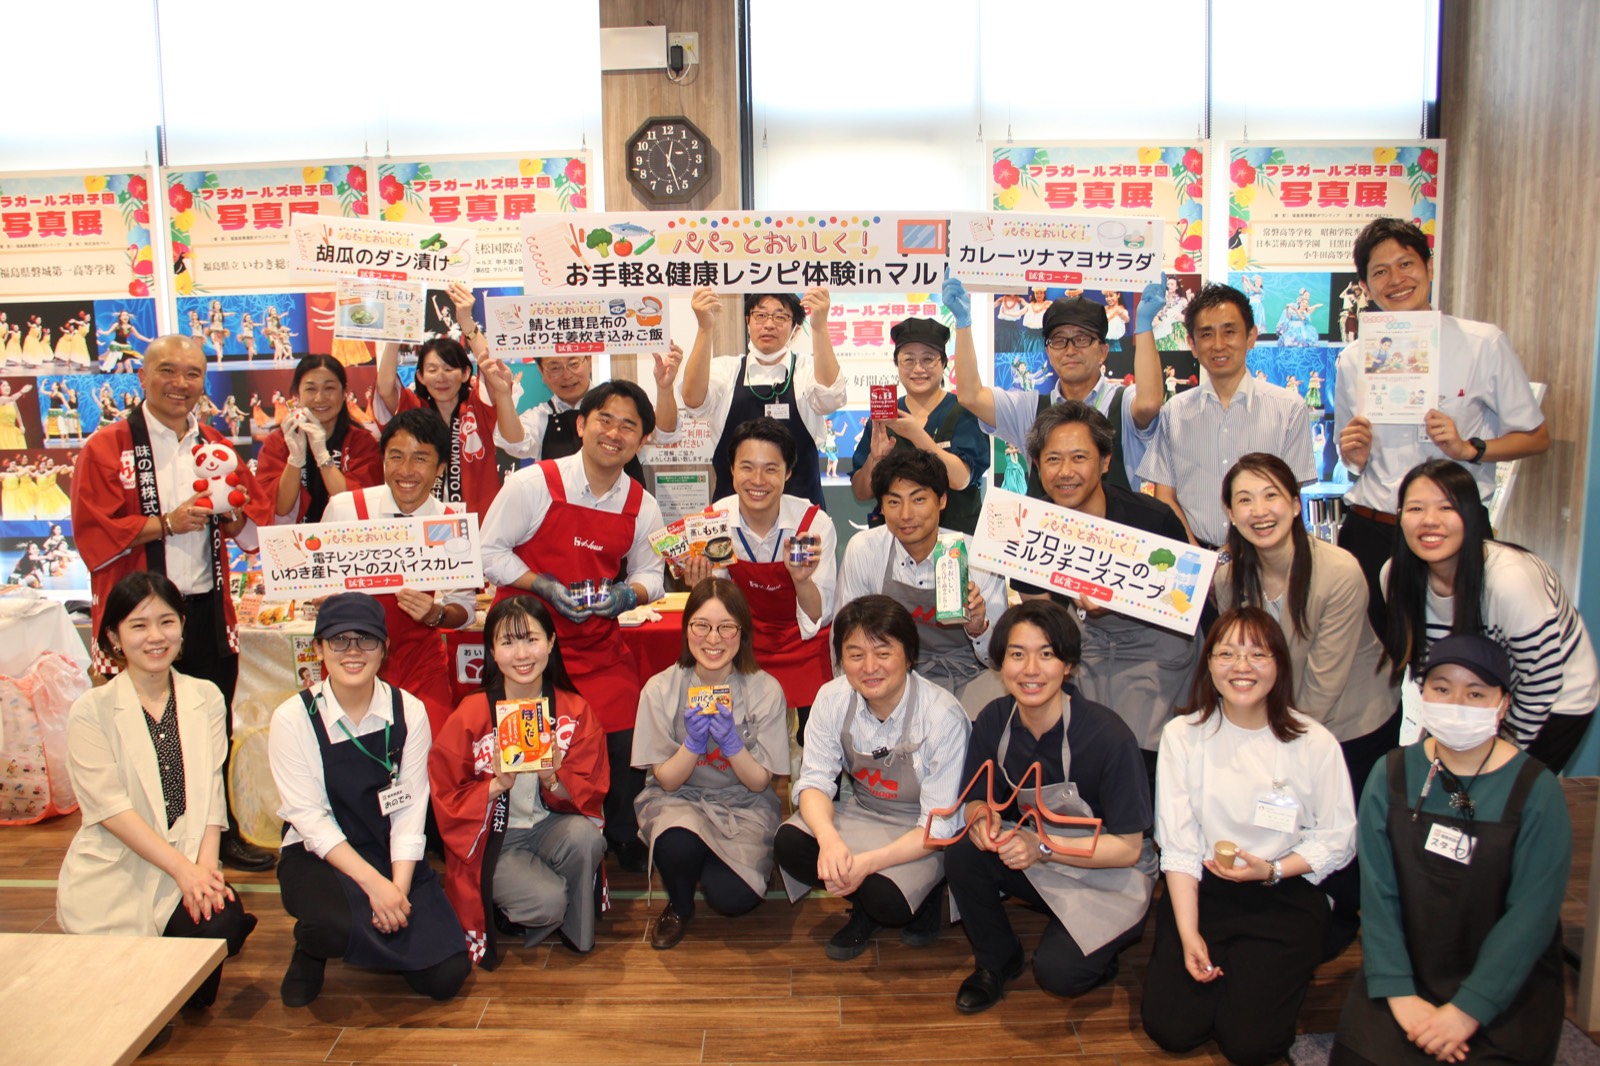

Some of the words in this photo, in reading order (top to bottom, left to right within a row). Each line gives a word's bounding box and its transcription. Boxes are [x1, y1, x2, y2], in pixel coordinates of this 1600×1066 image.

[647, 131, 657, 140] 11
[662, 126, 674, 135] 12
[681, 130, 687, 139] 1
[637, 142, 649, 151] 10
[692, 141, 698, 149] 2
[636, 157, 643, 166] 9
[695, 155, 702, 164] 3
[640, 169, 647, 178] 8
[691, 169, 699, 178] 4
[1029, 164, 1169, 178] フラガールズ甲子園
[1265, 164, 1404, 178] フラガールズ甲子園
[201, 184, 333, 201] フラガールズ甲子園
[413, 177, 551, 193] フラガールズ甲子園
[650, 181, 657, 190] 7
[666, 185, 673, 194] 6
[681, 181, 689, 189] 5
[1044, 181, 1154, 210] 写真展
[1279, 180, 1388, 209] 写真展
[429, 194, 537, 223] 写真展
[2, 210, 103, 238] 写真展
[203, 258, 290, 272] 福島県立いわき総
[316, 244, 451, 273] 胡瓜のダシ漬け
[960, 244, 1156, 272] カレーツナマヨサラダ
[1028, 271, 1079, 283] 試食コーナー
[529, 315, 627, 332] 鯖と椎茸昆布の
[496, 328, 663, 346] さっぱり生姜炊き込みご飯
[135, 445, 158, 518] 味の素株式
[312, 546, 424, 565] 電子レンジでつくろ！
[1025, 529, 1150, 579] ブロッコリーの
[271, 558, 474, 582] いわき産トマトのスパイスカレー
[1003, 539, 1166, 600] ミルクチーズスープ
[347, 577, 400, 589] 試食コーナー
[1053, 574, 1110, 599] 試食コーナー
[521, 709, 535, 747] ほんだし
